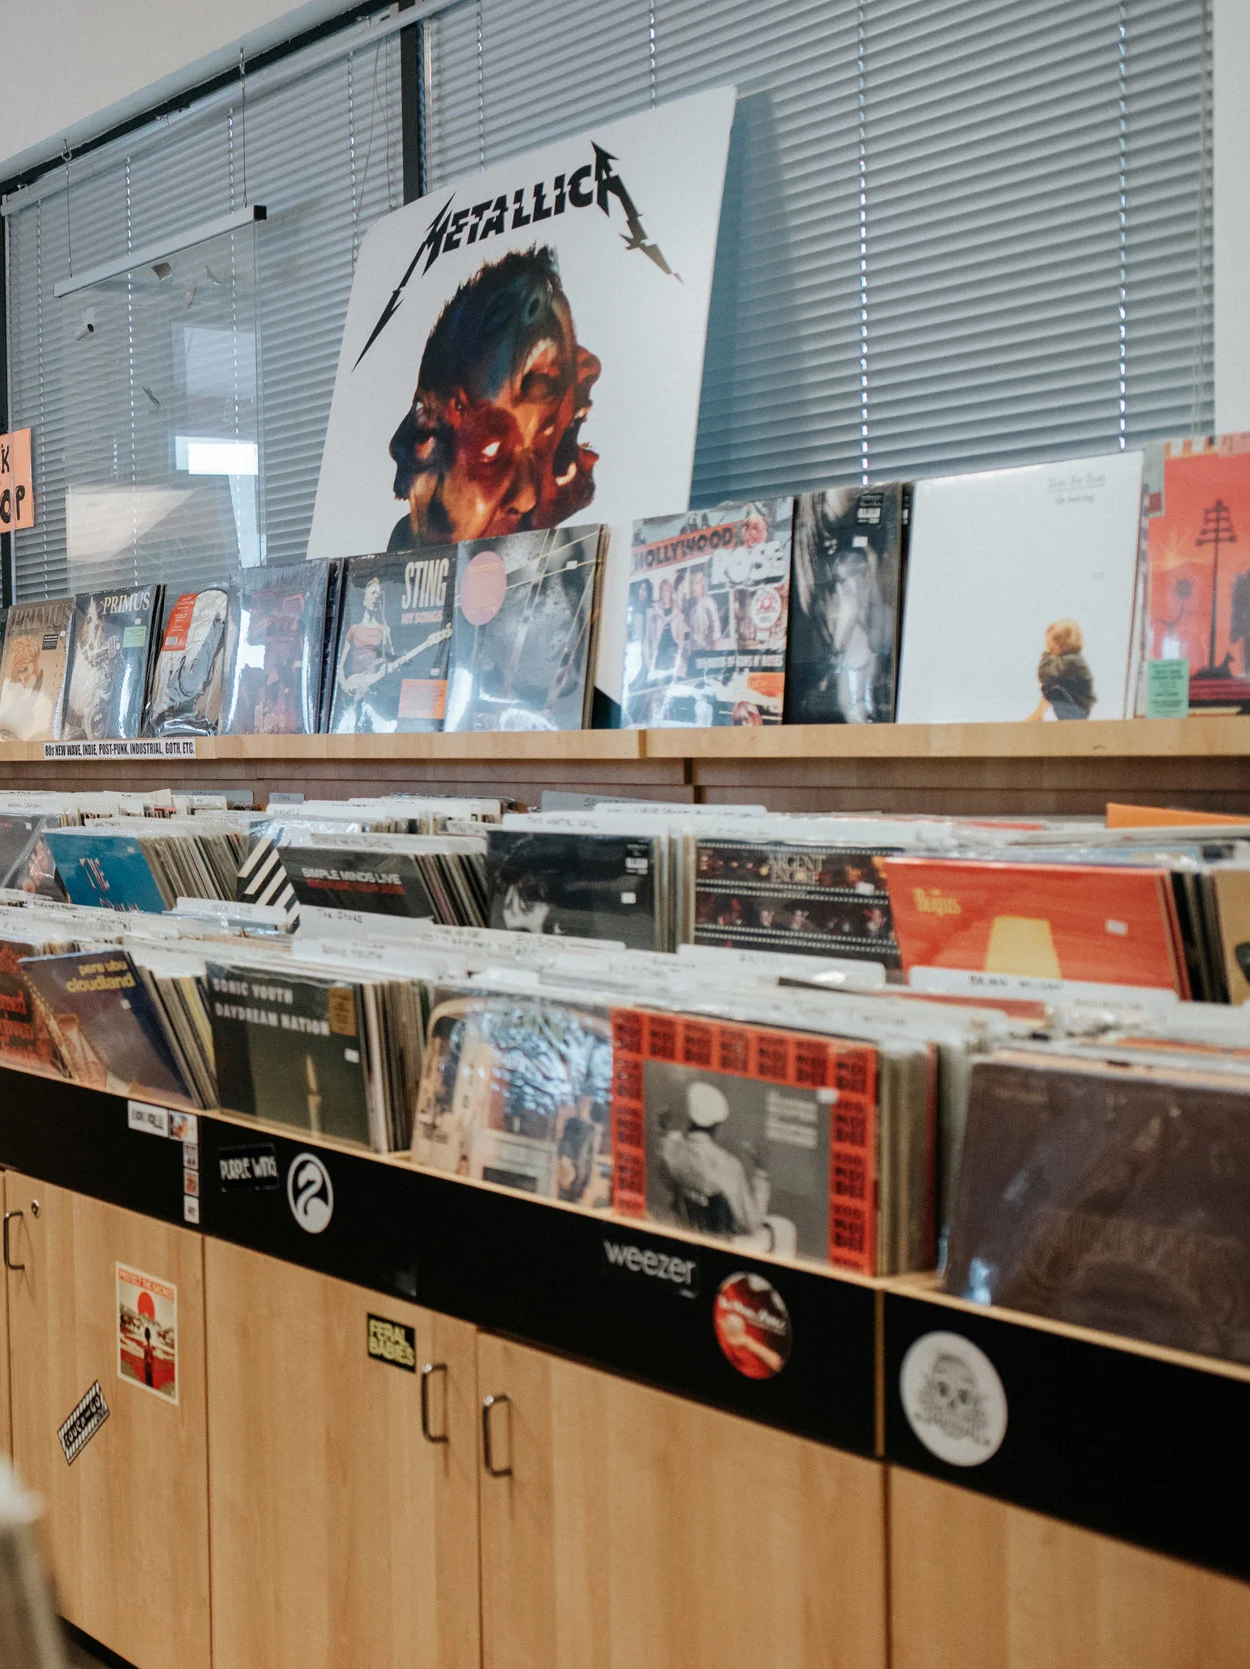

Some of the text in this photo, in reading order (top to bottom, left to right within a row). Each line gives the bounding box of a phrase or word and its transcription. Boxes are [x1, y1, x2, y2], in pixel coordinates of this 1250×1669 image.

[352, 141, 684, 373] METALLICA
[634, 527, 734, 571] HOLLYWOOD
[402, 558, 449, 609] STING
[102, 592, 150, 615] PRIMUS
[12, 602, 73, 631] PRIMUS
[414, 610, 444, 624] SONGS
[44, 745, 55, 756] 80s
[55, 744, 66, 756] NEW
[67, 744, 83, 756] WAVE,
[83, 744, 97, 755] INDIE,
[130, 742, 163, 755] INDUSTRIAL,
[183, 742, 195, 754] ETC.
[301, 867, 403, 885] SIMPLE MINDS LIVE
[78, 960, 129, 977] pere ubu
[66, 973, 136, 993] cloudland
[212, 978, 294, 1004] SONIC YOUTH
[214, 1002, 330, 1036] DAYDREAM NATION
[219, 1157, 252, 1180] PURPLE
[603, 1240, 697, 1286] weezer
[368, 1318, 408, 1343] FERAL
[368, 1335, 415, 1367] BABIES
